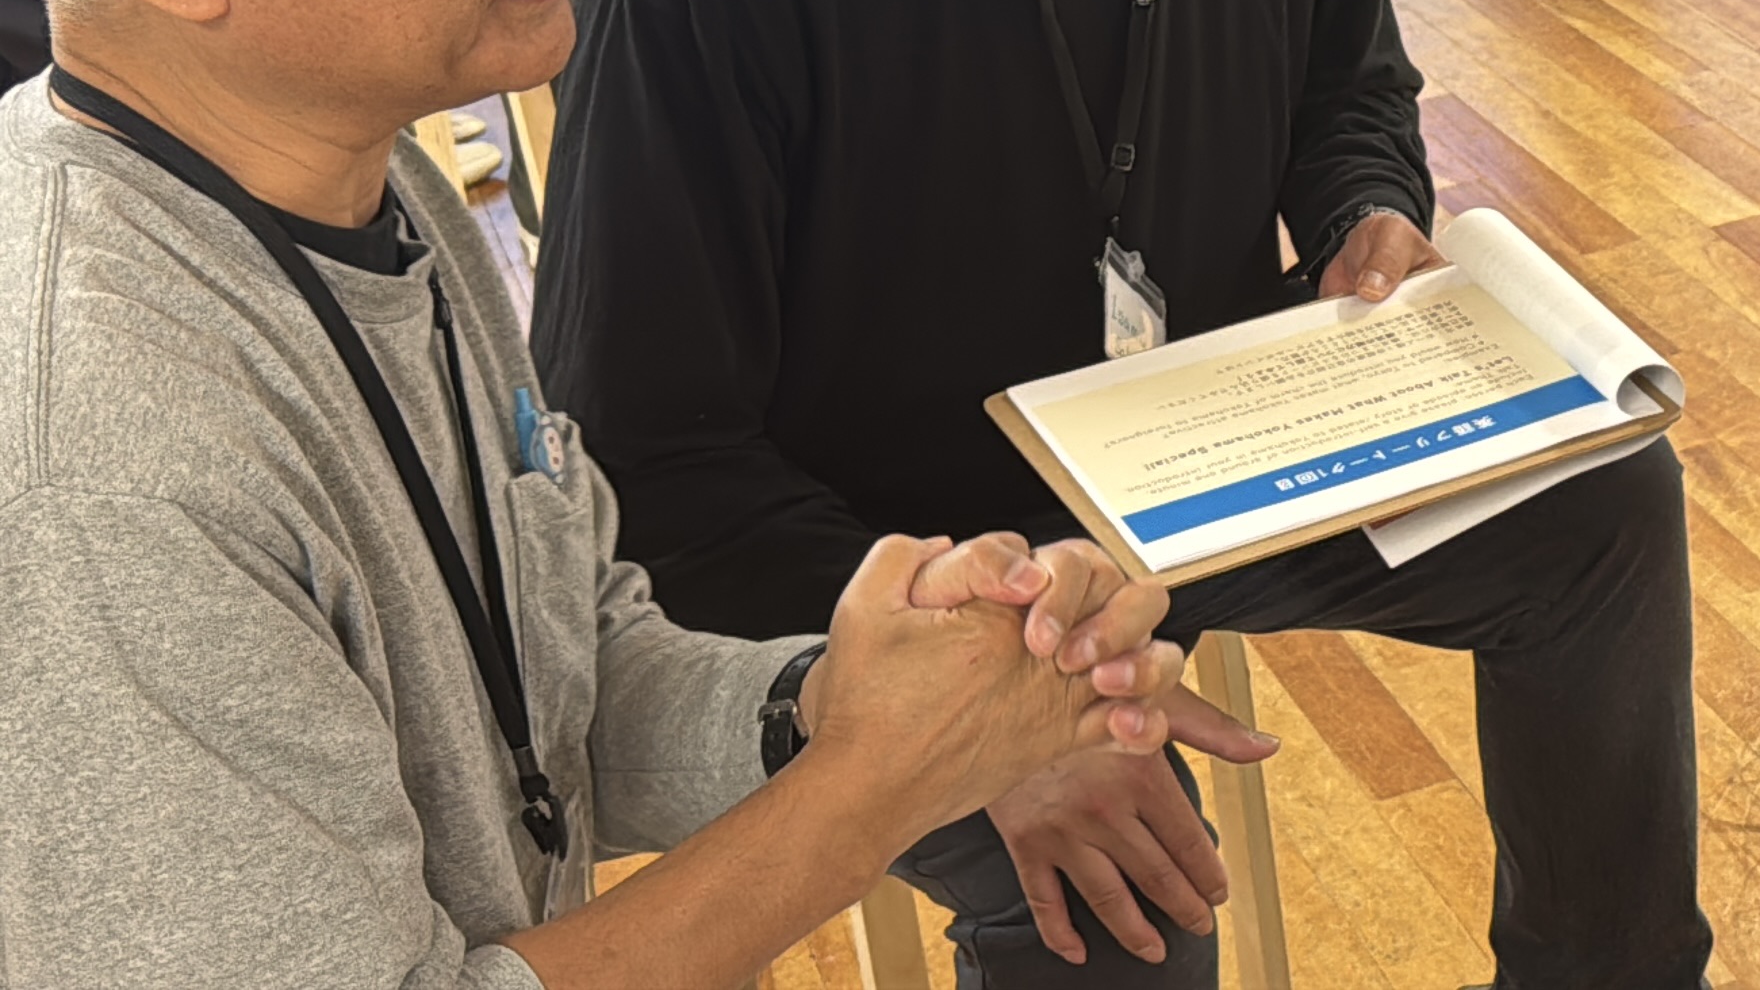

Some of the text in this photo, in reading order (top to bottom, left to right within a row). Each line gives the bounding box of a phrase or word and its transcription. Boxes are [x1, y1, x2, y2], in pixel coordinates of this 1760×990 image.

[1474, 356, 1514, 371] Let's
[1439, 370, 1472, 382] Talk
[1389, 380, 1434, 398] About
[1347, 395, 1387, 411] What
[1295, 407, 1344, 425] Makes
[1213, 423, 1293, 448] Yokohama
